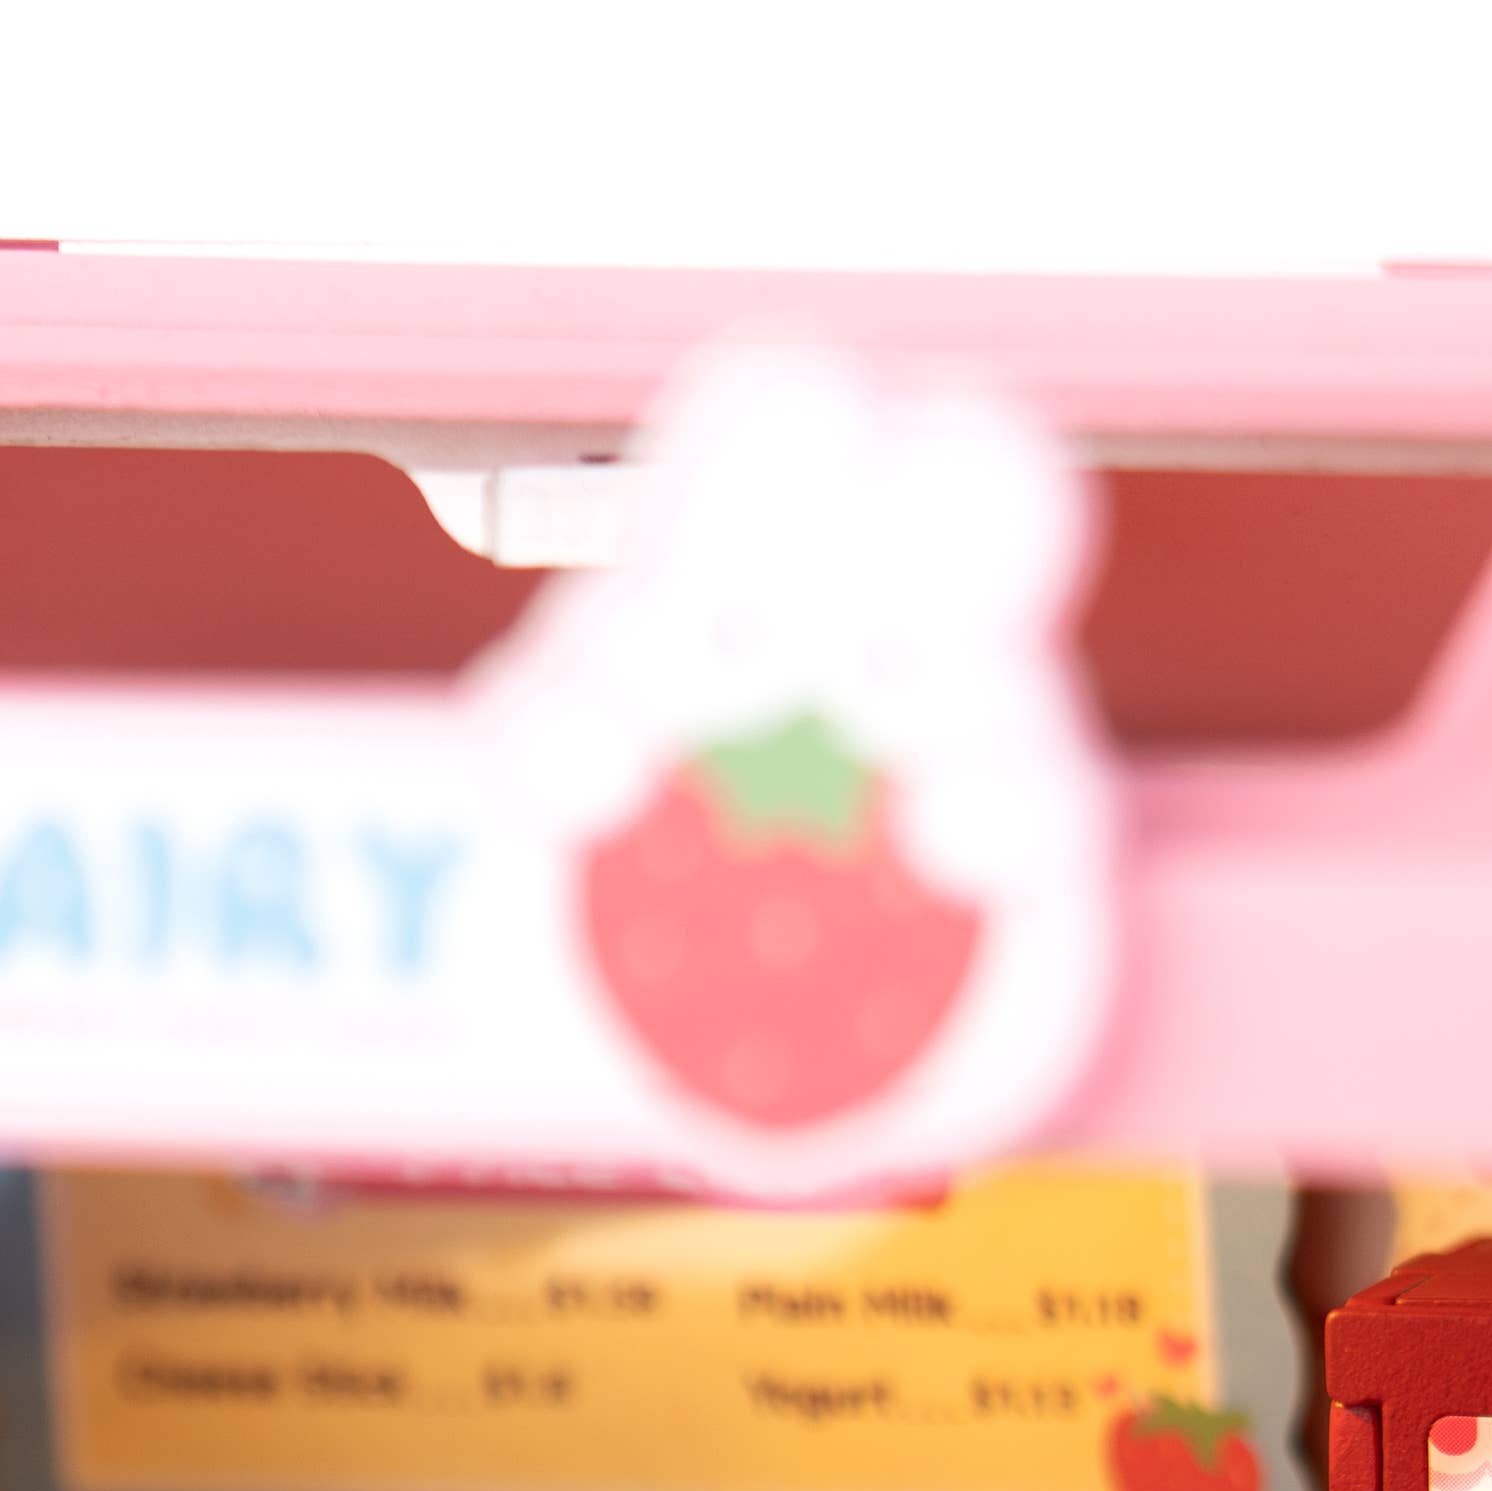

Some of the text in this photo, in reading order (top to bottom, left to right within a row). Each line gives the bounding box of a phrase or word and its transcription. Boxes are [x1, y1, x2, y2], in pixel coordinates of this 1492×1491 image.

[739, 1283, 845, 1326] Plain
[862, 1283, 953, 1326] Milk
[744, 1369, 892, 1431] Yogurt
